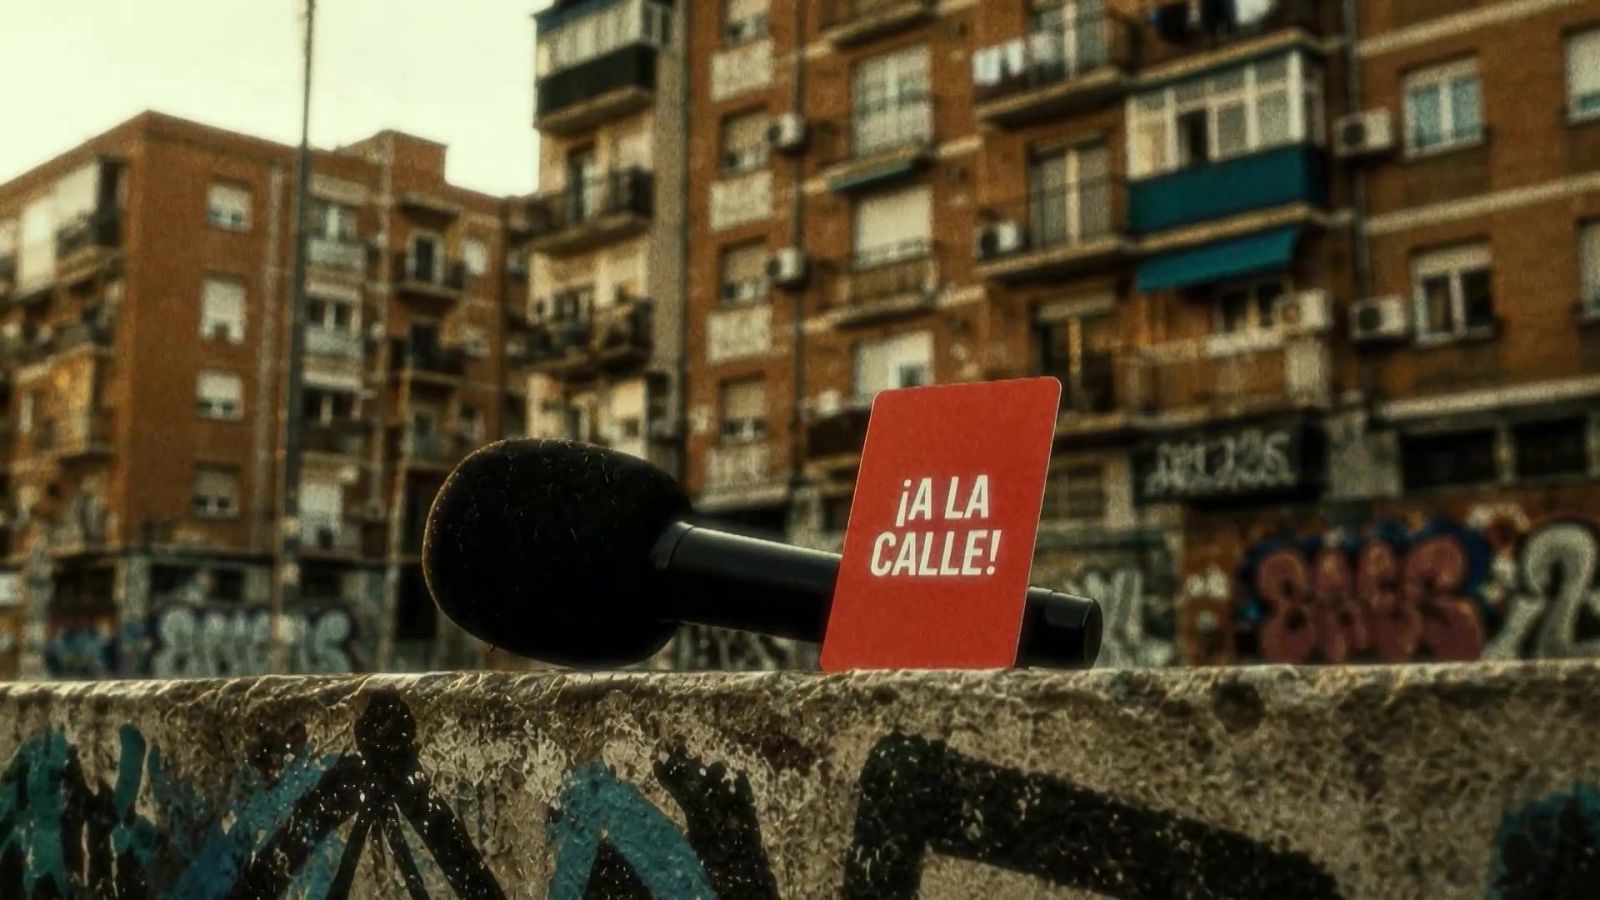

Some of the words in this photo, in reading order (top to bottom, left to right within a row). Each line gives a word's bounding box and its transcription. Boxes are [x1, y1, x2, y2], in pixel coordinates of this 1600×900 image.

[894, 476, 933, 528] ¡A
[944, 474, 990, 521] LA
[870, 529, 1002, 577] CALLE!
